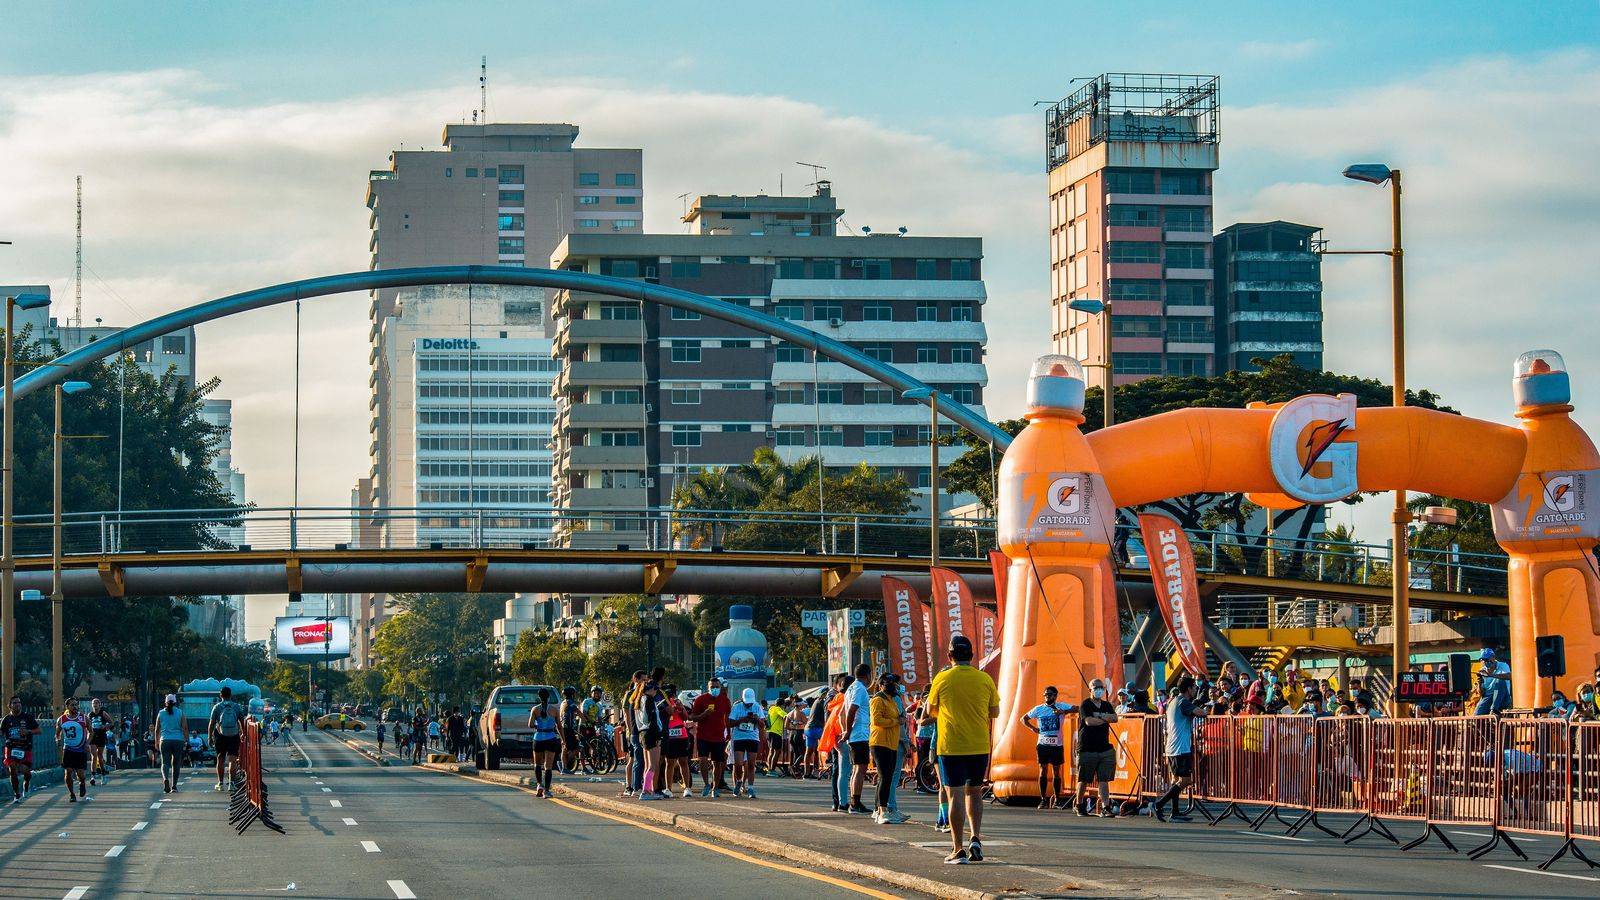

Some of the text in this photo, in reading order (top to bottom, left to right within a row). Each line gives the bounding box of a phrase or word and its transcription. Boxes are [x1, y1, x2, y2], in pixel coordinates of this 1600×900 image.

[423, 338, 480, 350] Deloitte.
[1038, 516, 1090, 525] GATORADE
[1536, 512, 1586, 523] GATORADE
[1159, 528, 1192, 656] GATORADE
[804, 611, 863, 621] PARO
[896, 589, 917, 684] GATORADE
